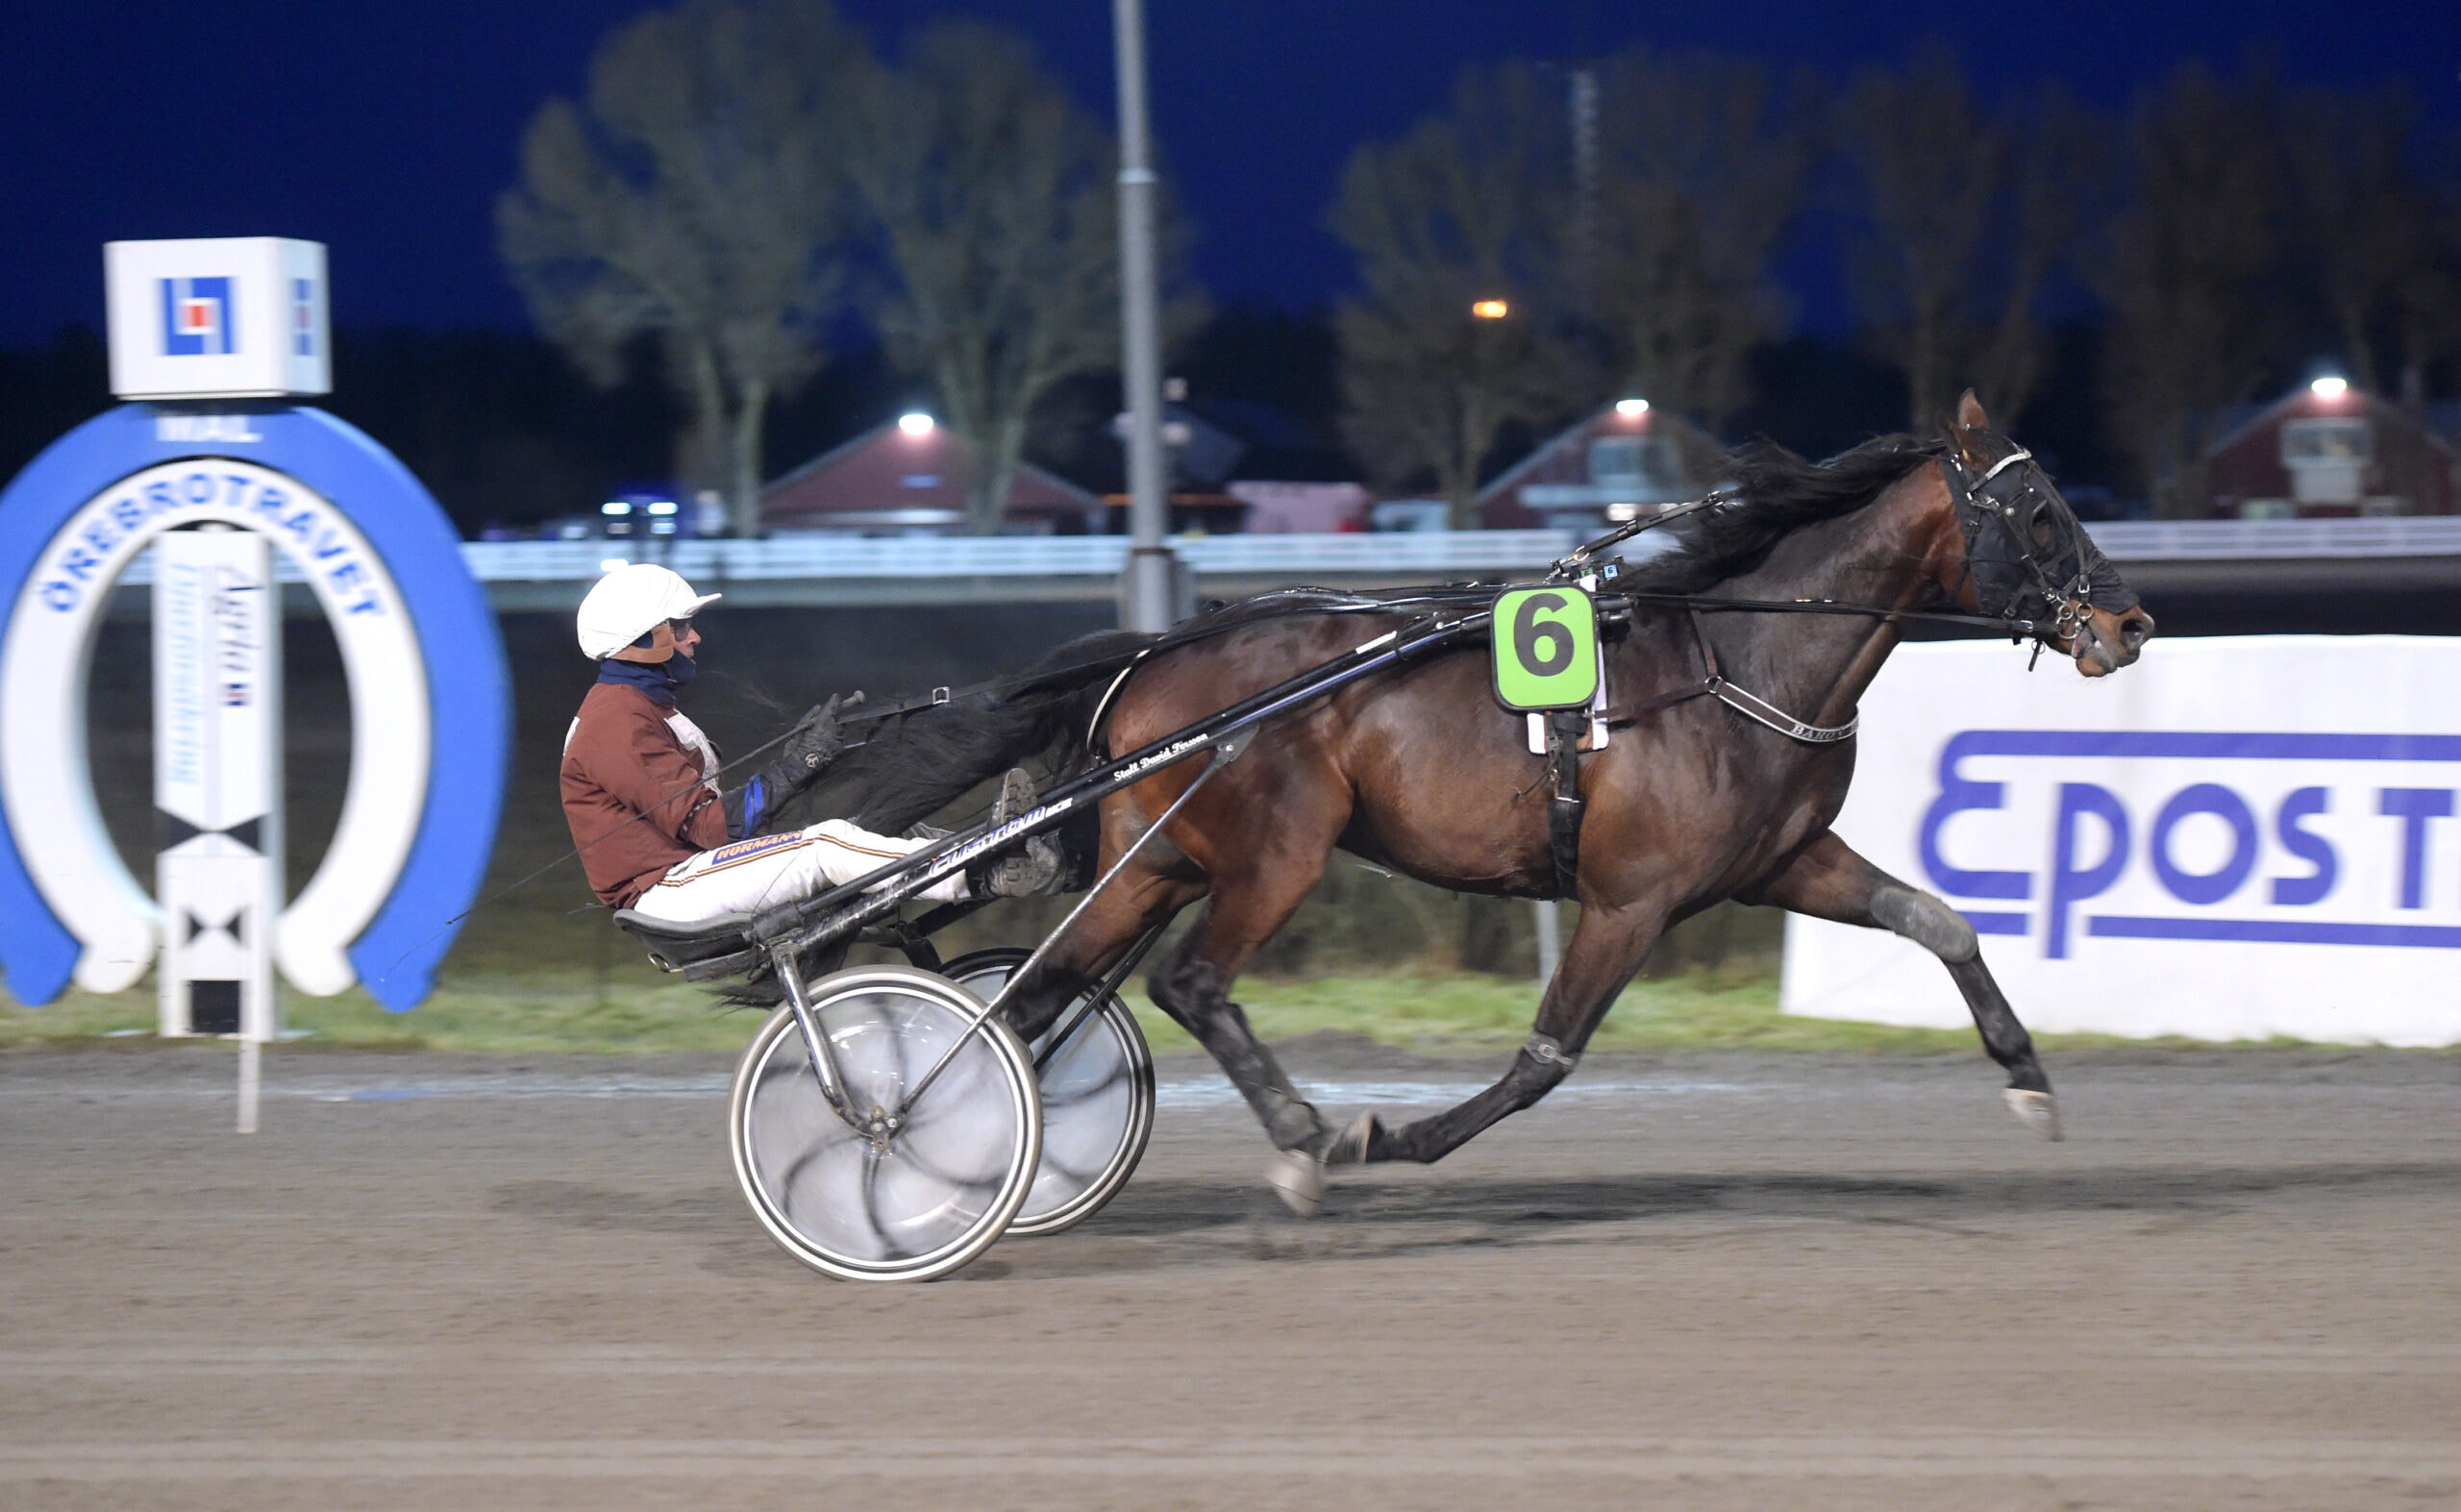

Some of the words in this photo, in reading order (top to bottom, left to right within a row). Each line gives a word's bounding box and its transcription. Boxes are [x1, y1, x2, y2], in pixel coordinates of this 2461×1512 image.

[1513, 592, 1575, 677] 6
[1113, 762, 1140, 781] Stall
[1139, 747, 1172, 769] David
